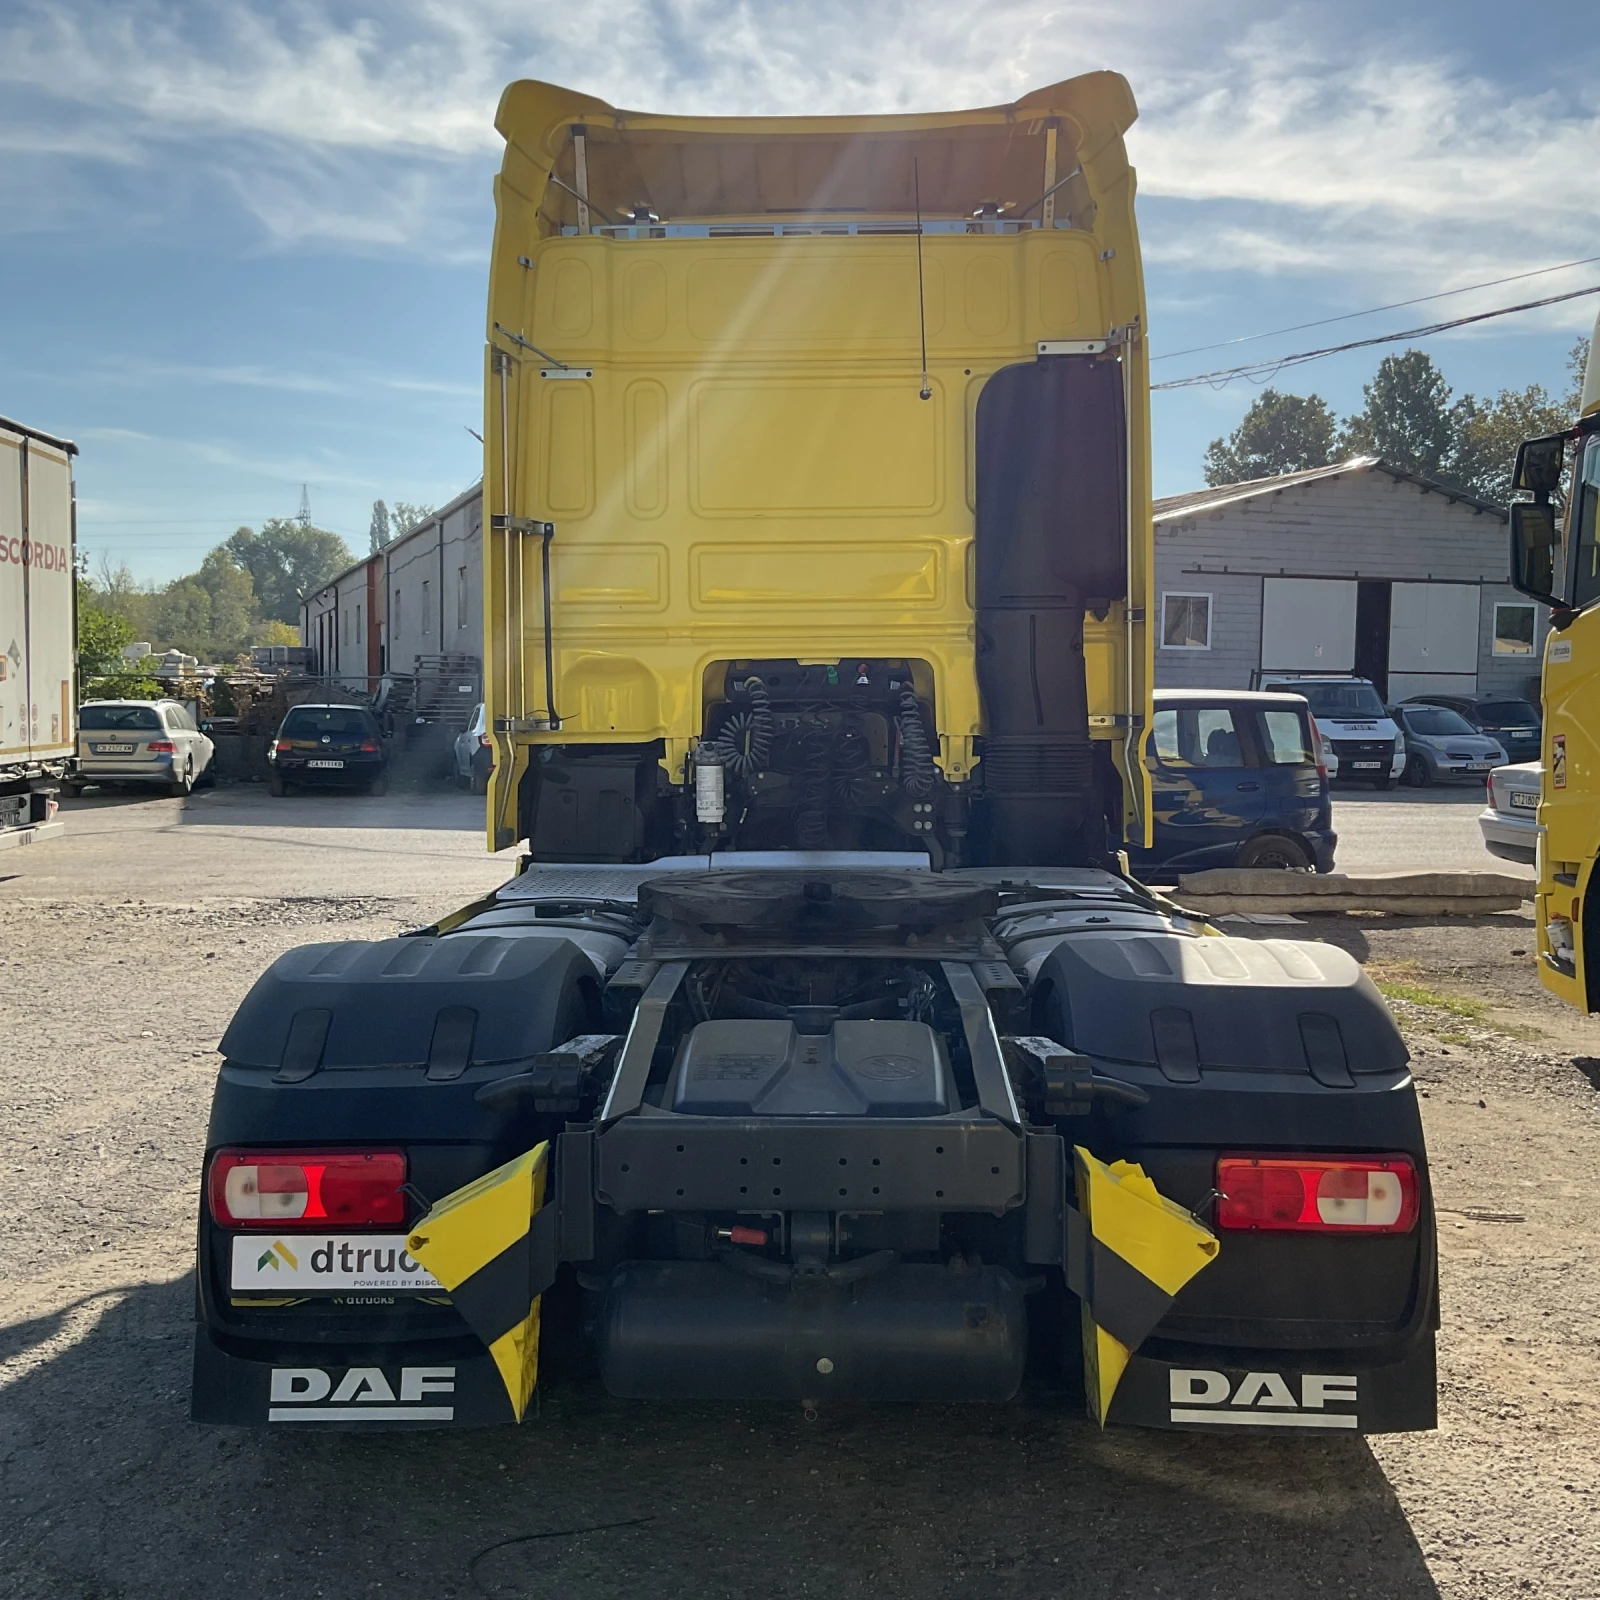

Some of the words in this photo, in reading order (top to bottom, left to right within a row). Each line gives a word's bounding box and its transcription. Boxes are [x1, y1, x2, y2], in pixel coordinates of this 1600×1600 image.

[0, 535, 68, 573] SCORDIA
[310, 1240, 430, 1273] dtruc
[270, 1367, 456, 1402] DAF
[1170, 1369, 1357, 1408] DAF
